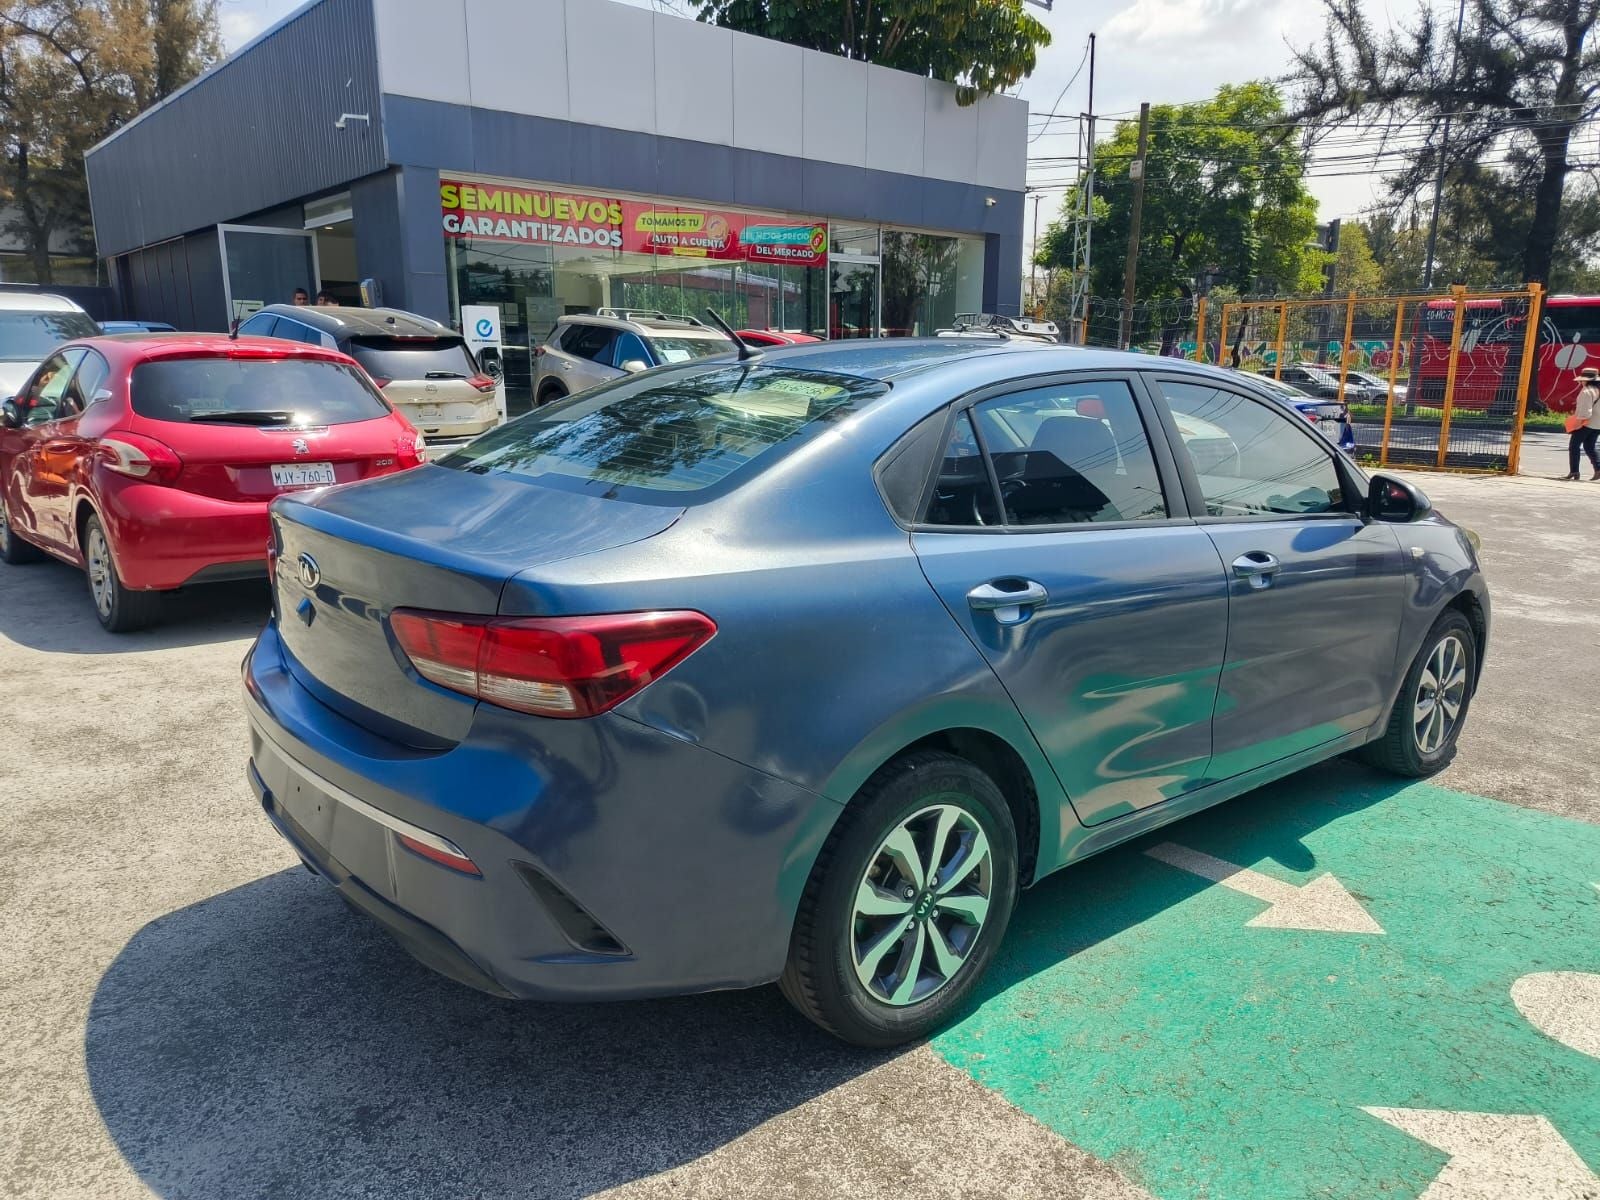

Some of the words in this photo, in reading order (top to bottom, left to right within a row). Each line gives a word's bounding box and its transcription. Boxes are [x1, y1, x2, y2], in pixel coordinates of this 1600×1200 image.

[440, 185, 623, 225] SEMINUEVOS
[641, 218, 686, 226] TOMAMOS
[689, 219, 699, 227] TU
[443, 214, 622, 247] GARANTIZADOS
[652, 235, 678, 244] AUTO
[690, 238, 725, 248] CUENTA
[756, 245, 772, 255] DEL
[774, 248, 814, 258] MERCADO
[274, 470, 333, 484] MJY-760-D
[918, 893, 932, 914] KIA
